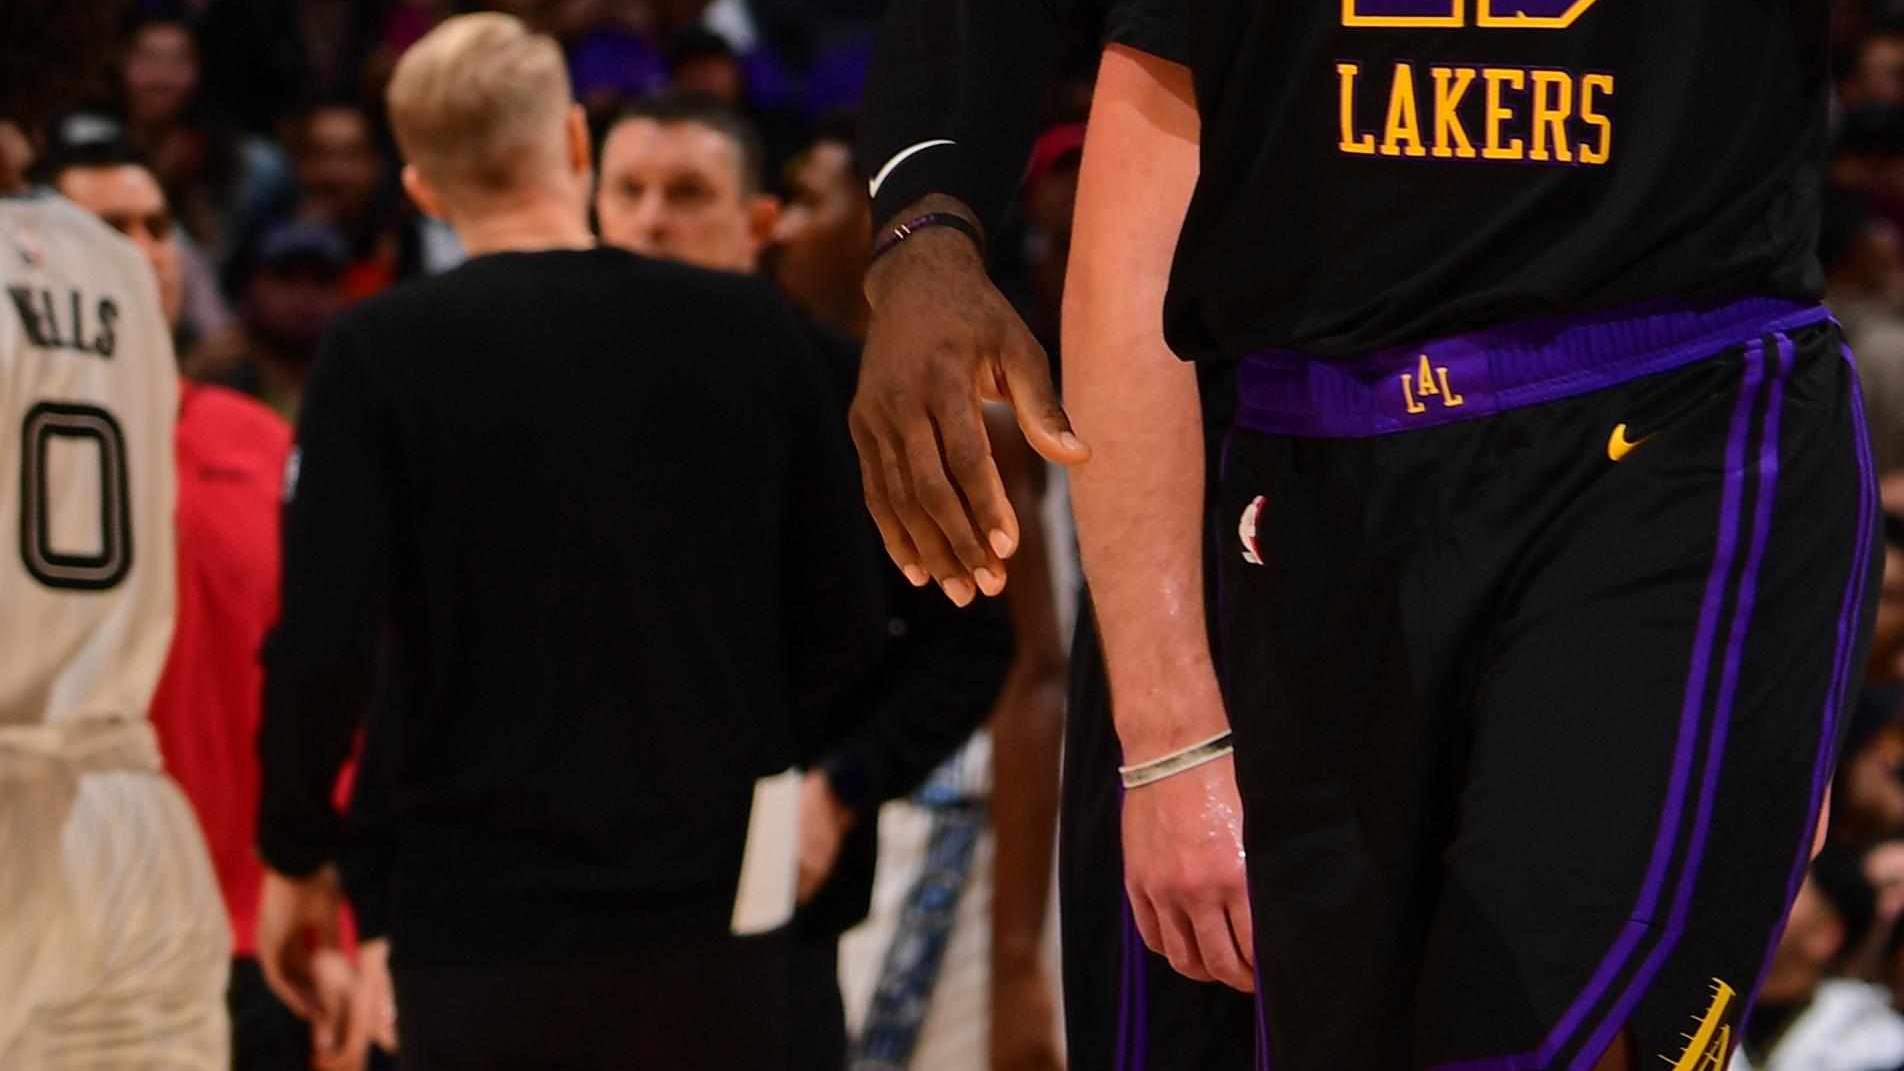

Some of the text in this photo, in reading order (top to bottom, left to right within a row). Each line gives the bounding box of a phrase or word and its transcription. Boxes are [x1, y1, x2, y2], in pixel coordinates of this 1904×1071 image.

[1337, 63, 1614, 165] LAKERS
[1401, 354, 1464, 414] LAL
[20, 401, 133, 591] 0
